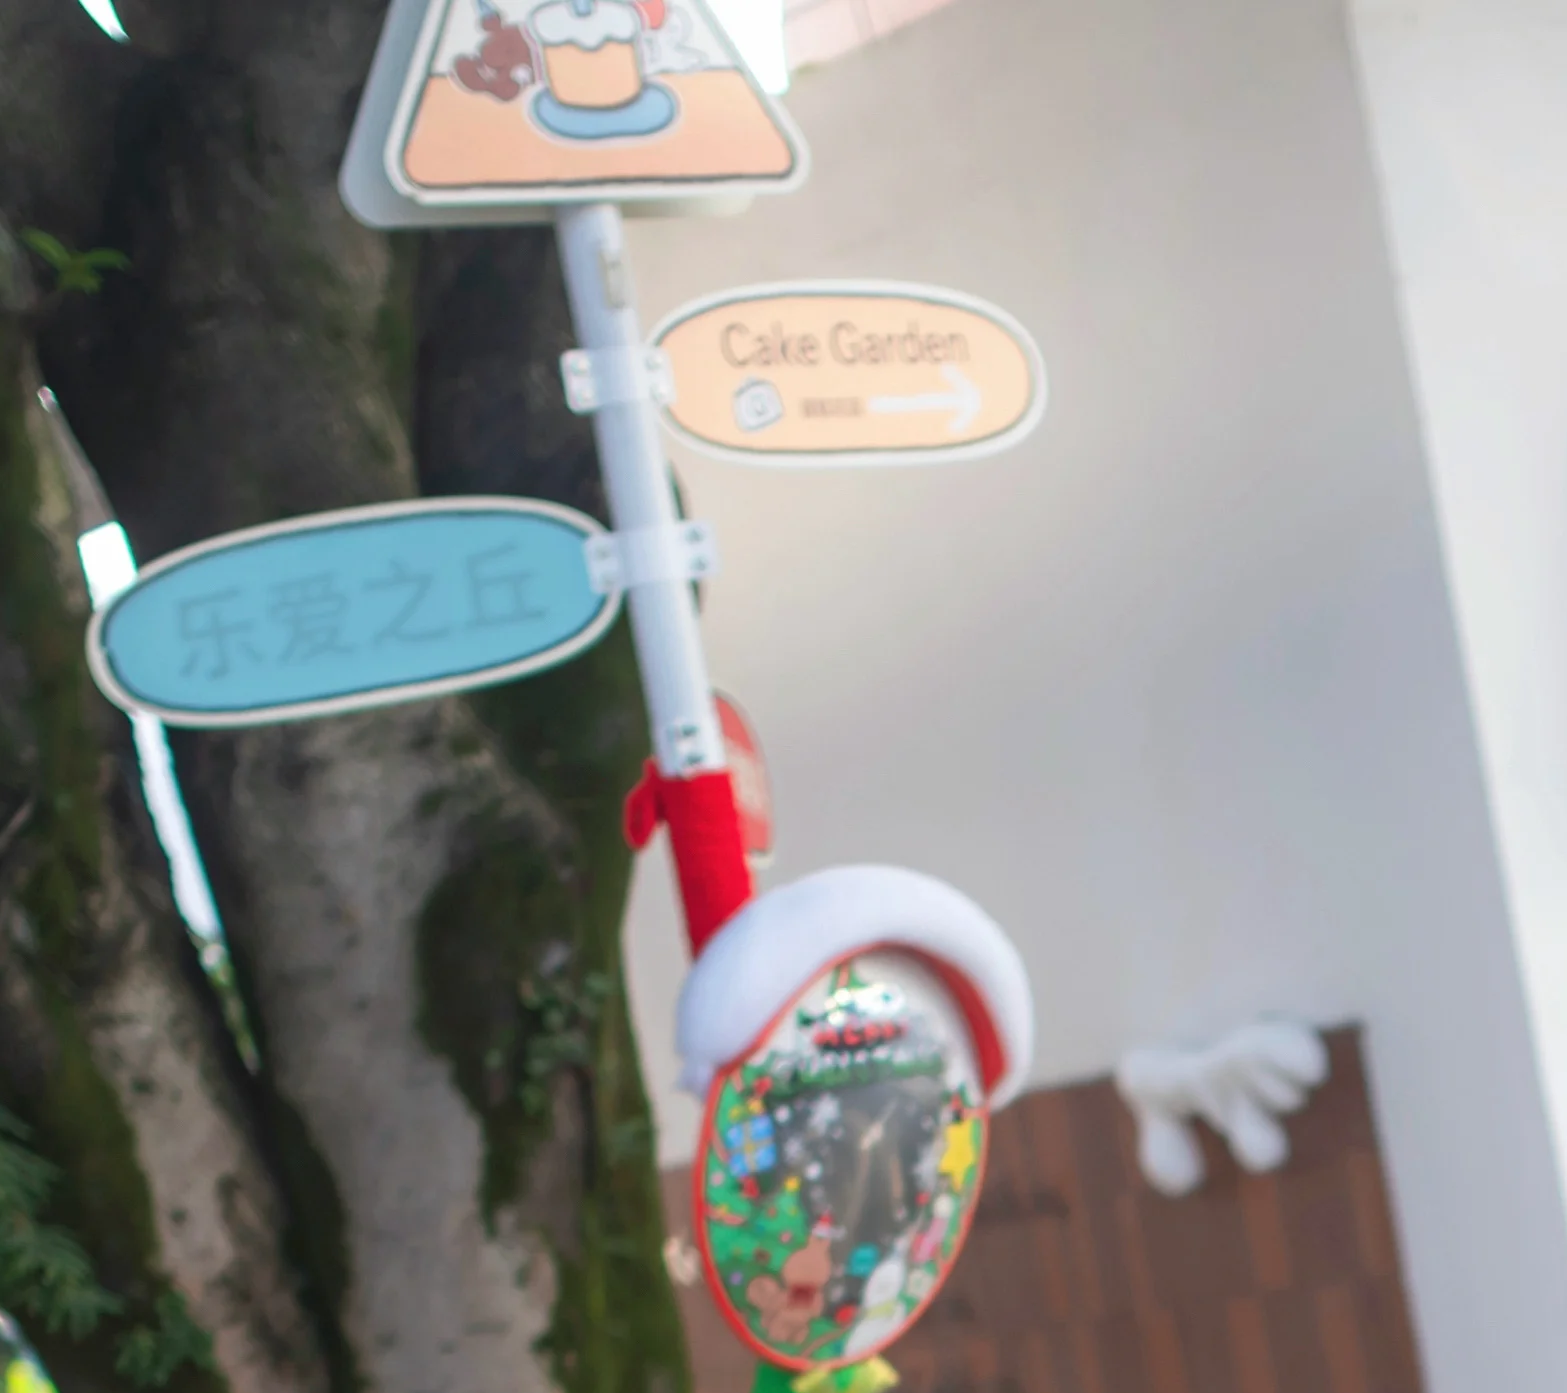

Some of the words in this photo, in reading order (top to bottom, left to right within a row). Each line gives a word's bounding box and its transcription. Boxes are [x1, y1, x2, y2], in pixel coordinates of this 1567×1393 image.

[720, 322, 821, 367] Cake
[829, 320, 971, 366] Garden
[178, 542, 549, 681] 乐爱之丘
